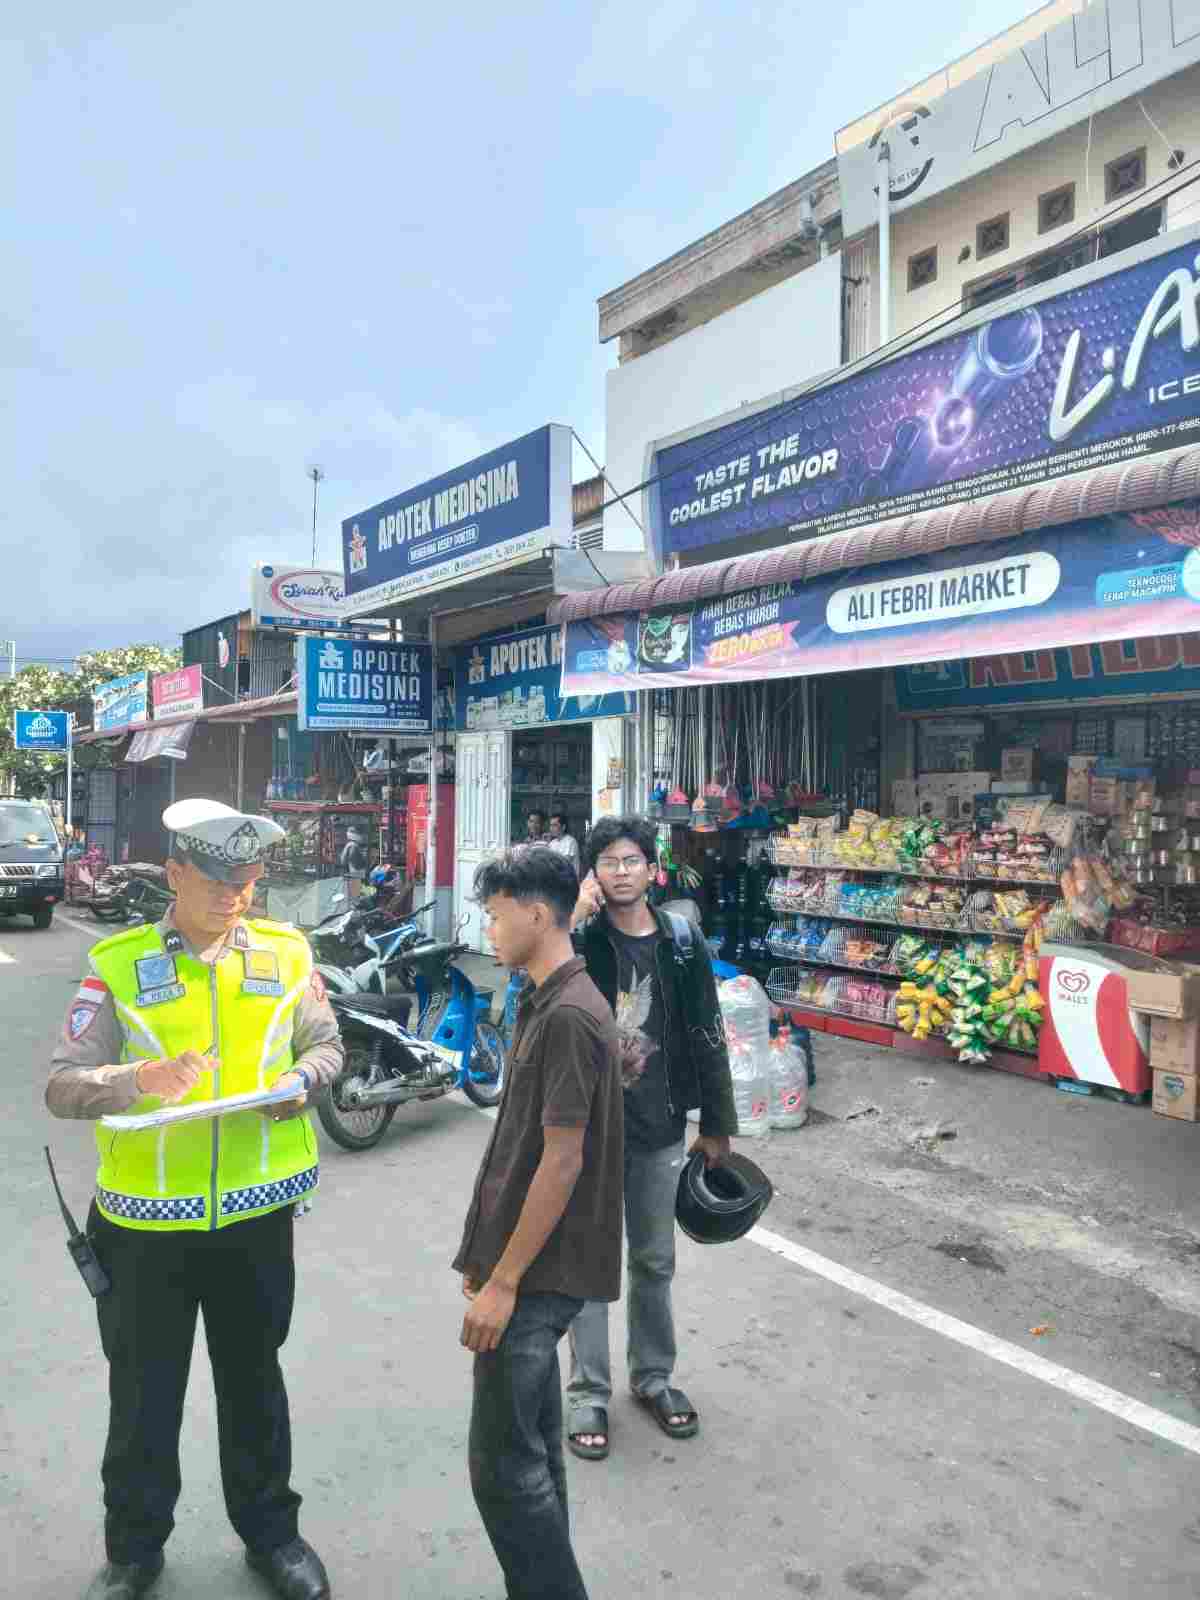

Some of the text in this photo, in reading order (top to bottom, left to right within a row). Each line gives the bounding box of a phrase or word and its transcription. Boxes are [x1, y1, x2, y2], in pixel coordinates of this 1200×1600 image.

[695, 432, 801, 493] TASTE THE
[1090, 436, 1133, 454] MEROKOK
[378, 460, 519, 552] APOTEK MEDISINA
[669, 447, 840, 527] COOLEST FLAVOR
[848, 564, 1031, 622] ALI FEBRI MARKET
[352, 648, 421, 673] APOTEK
[490, 632, 547, 677] APOTEK
[318, 671, 421, 702] MEDISINA
